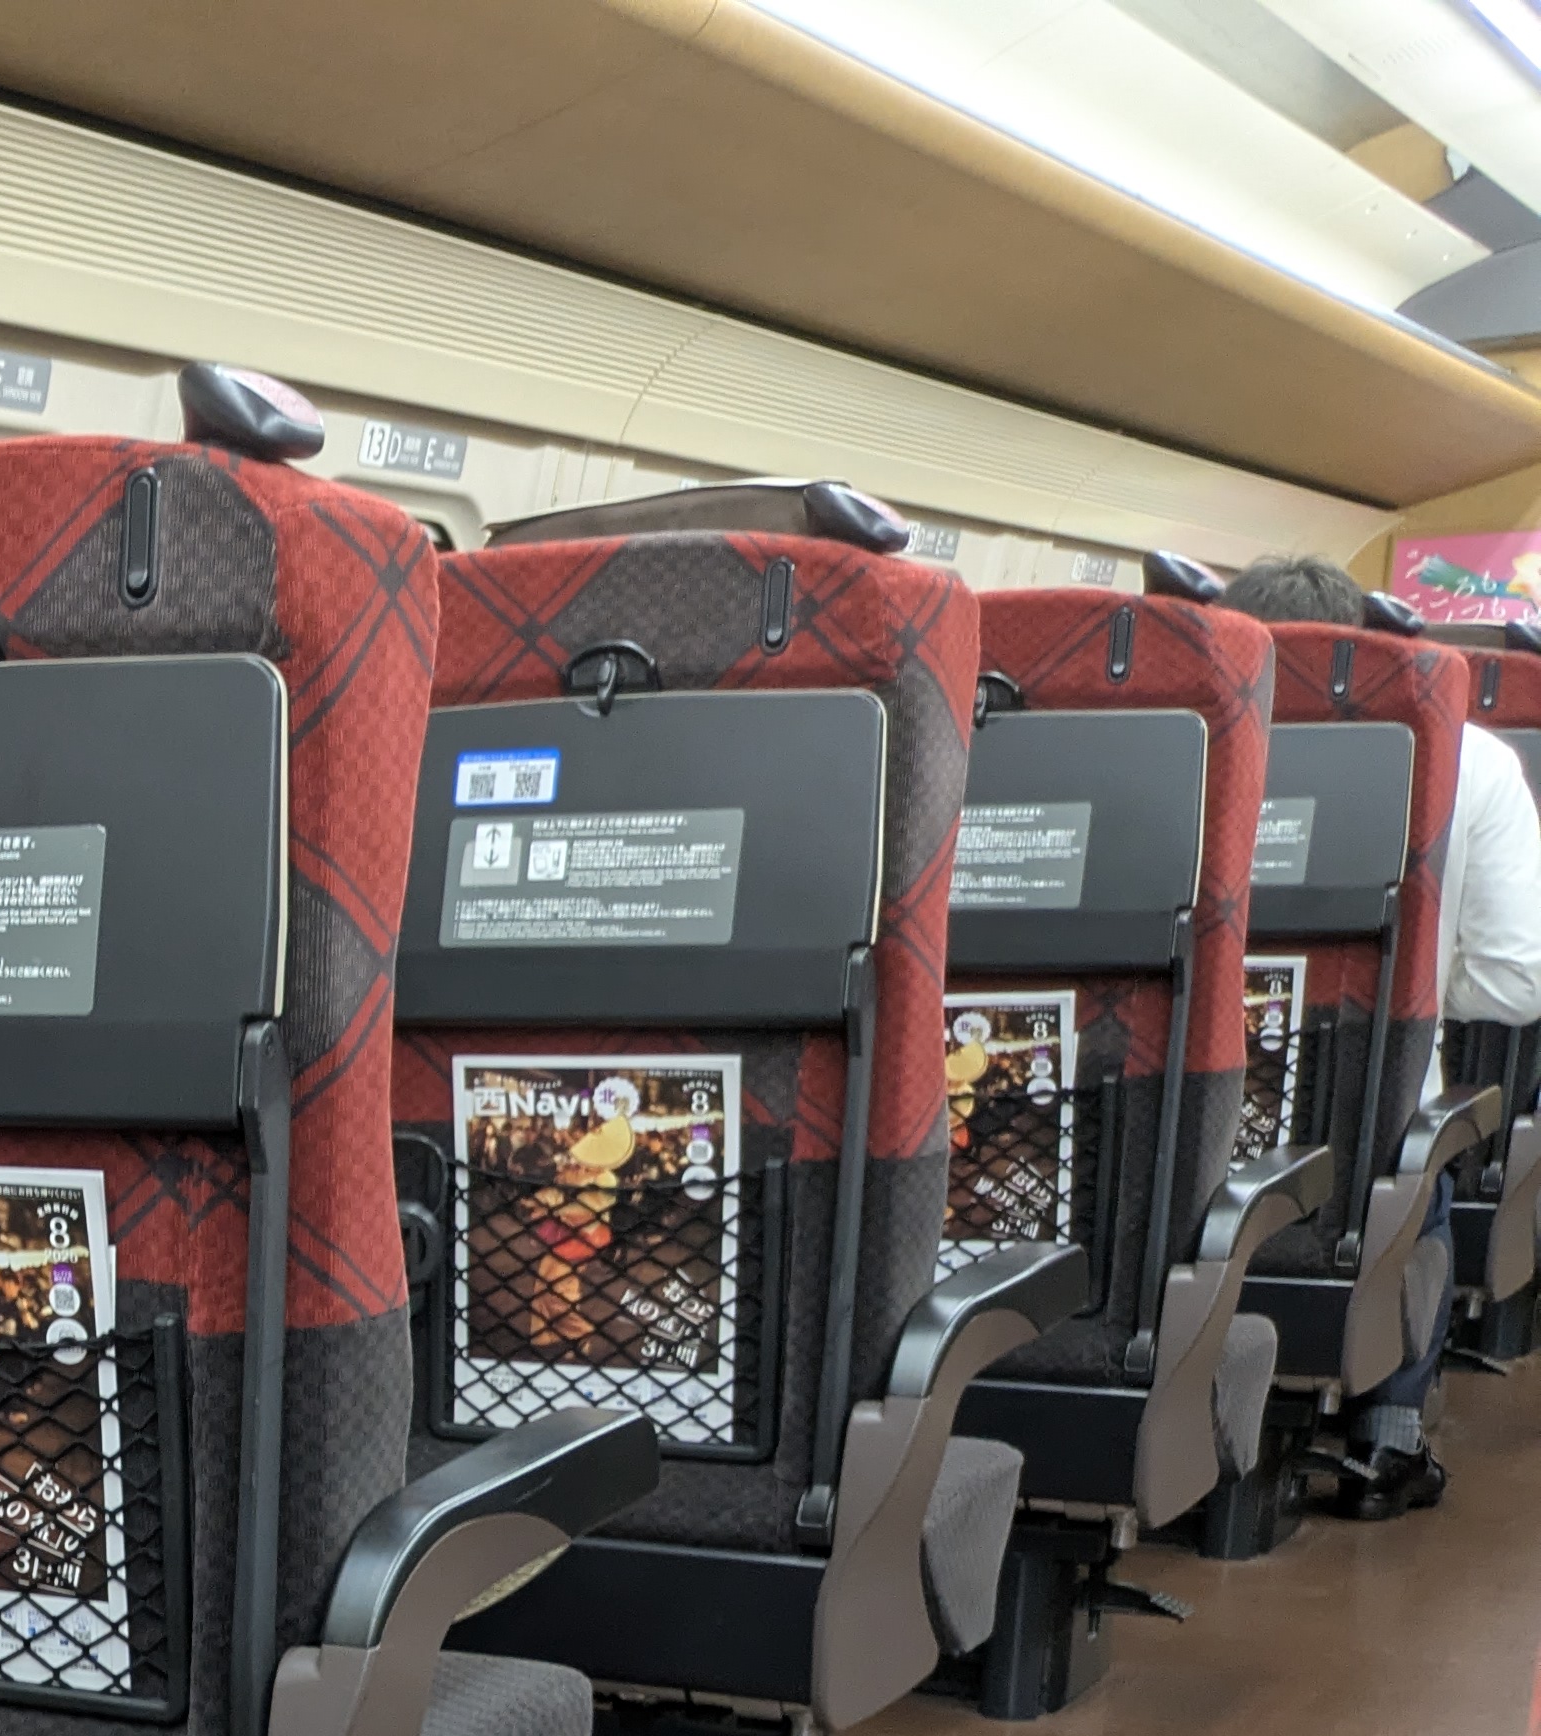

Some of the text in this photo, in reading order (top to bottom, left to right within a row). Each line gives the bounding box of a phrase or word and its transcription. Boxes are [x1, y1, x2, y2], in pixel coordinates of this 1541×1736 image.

[367, 426, 386, 462] 13
[387, 430, 402, 465] D
[423, 436, 438, 472] E
[473, 1086, 591, 1119] 西Navi
[691, 1090, 710, 1115] 8
[49, 1216, 71, 1249] 8
